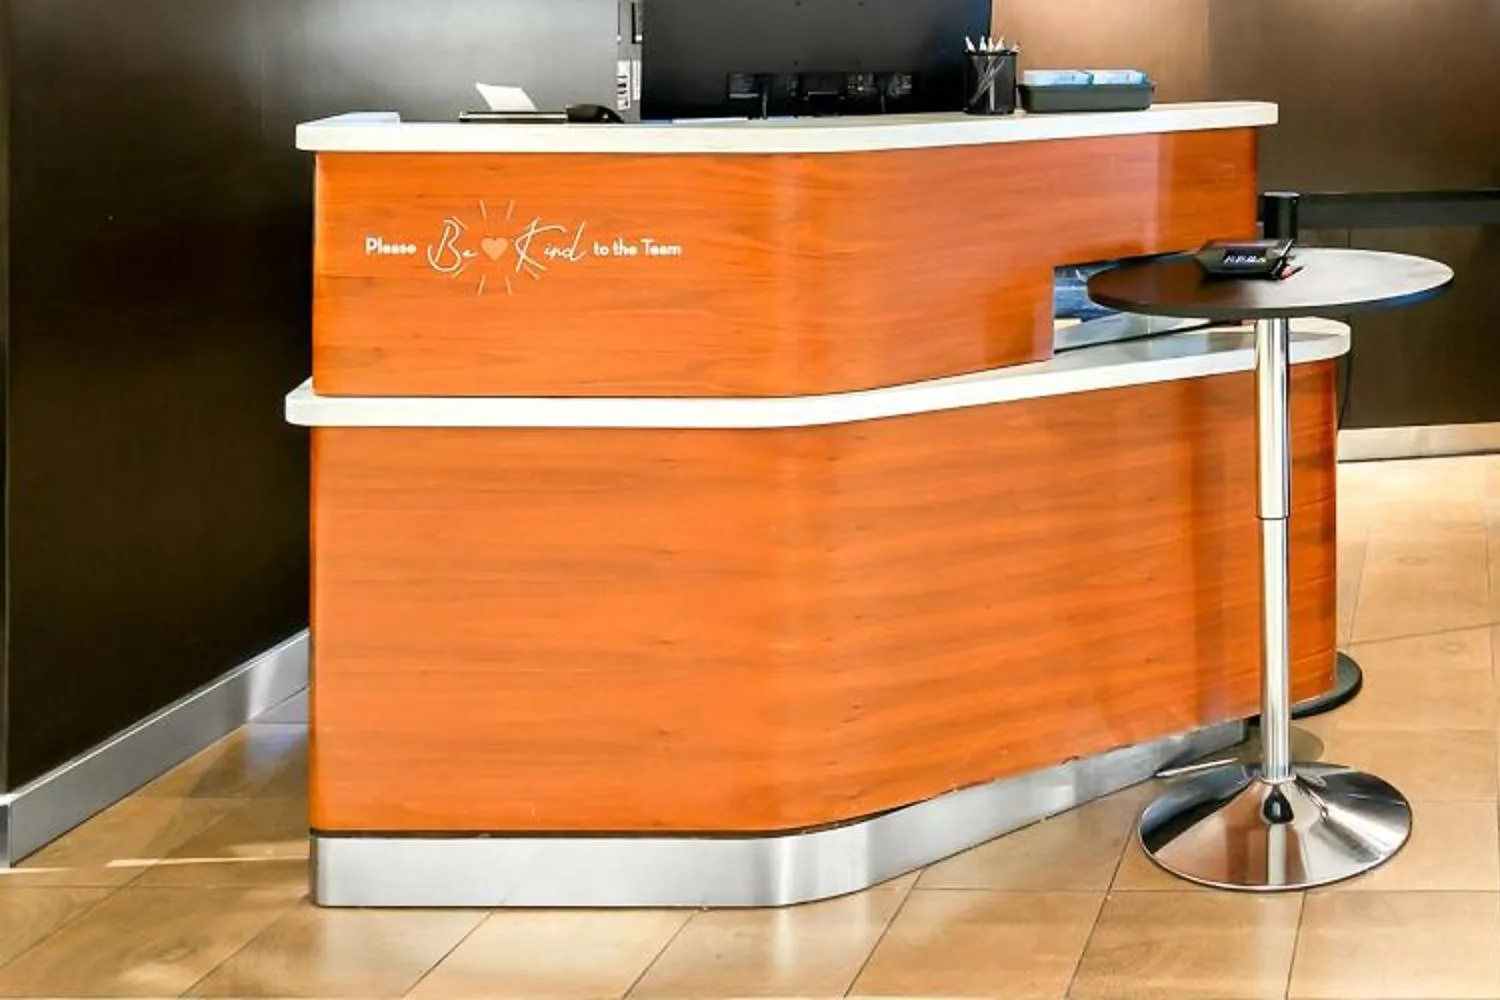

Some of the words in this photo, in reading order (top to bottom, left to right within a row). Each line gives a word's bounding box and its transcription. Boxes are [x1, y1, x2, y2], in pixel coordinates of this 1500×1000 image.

[365, 236, 417, 256] Please
[427, 217, 478, 272] Be
[514, 217, 588, 273] Kind
[593, 238, 609, 256] to
[612, 236, 638, 256] the
[641, 237, 683, 256] Team
